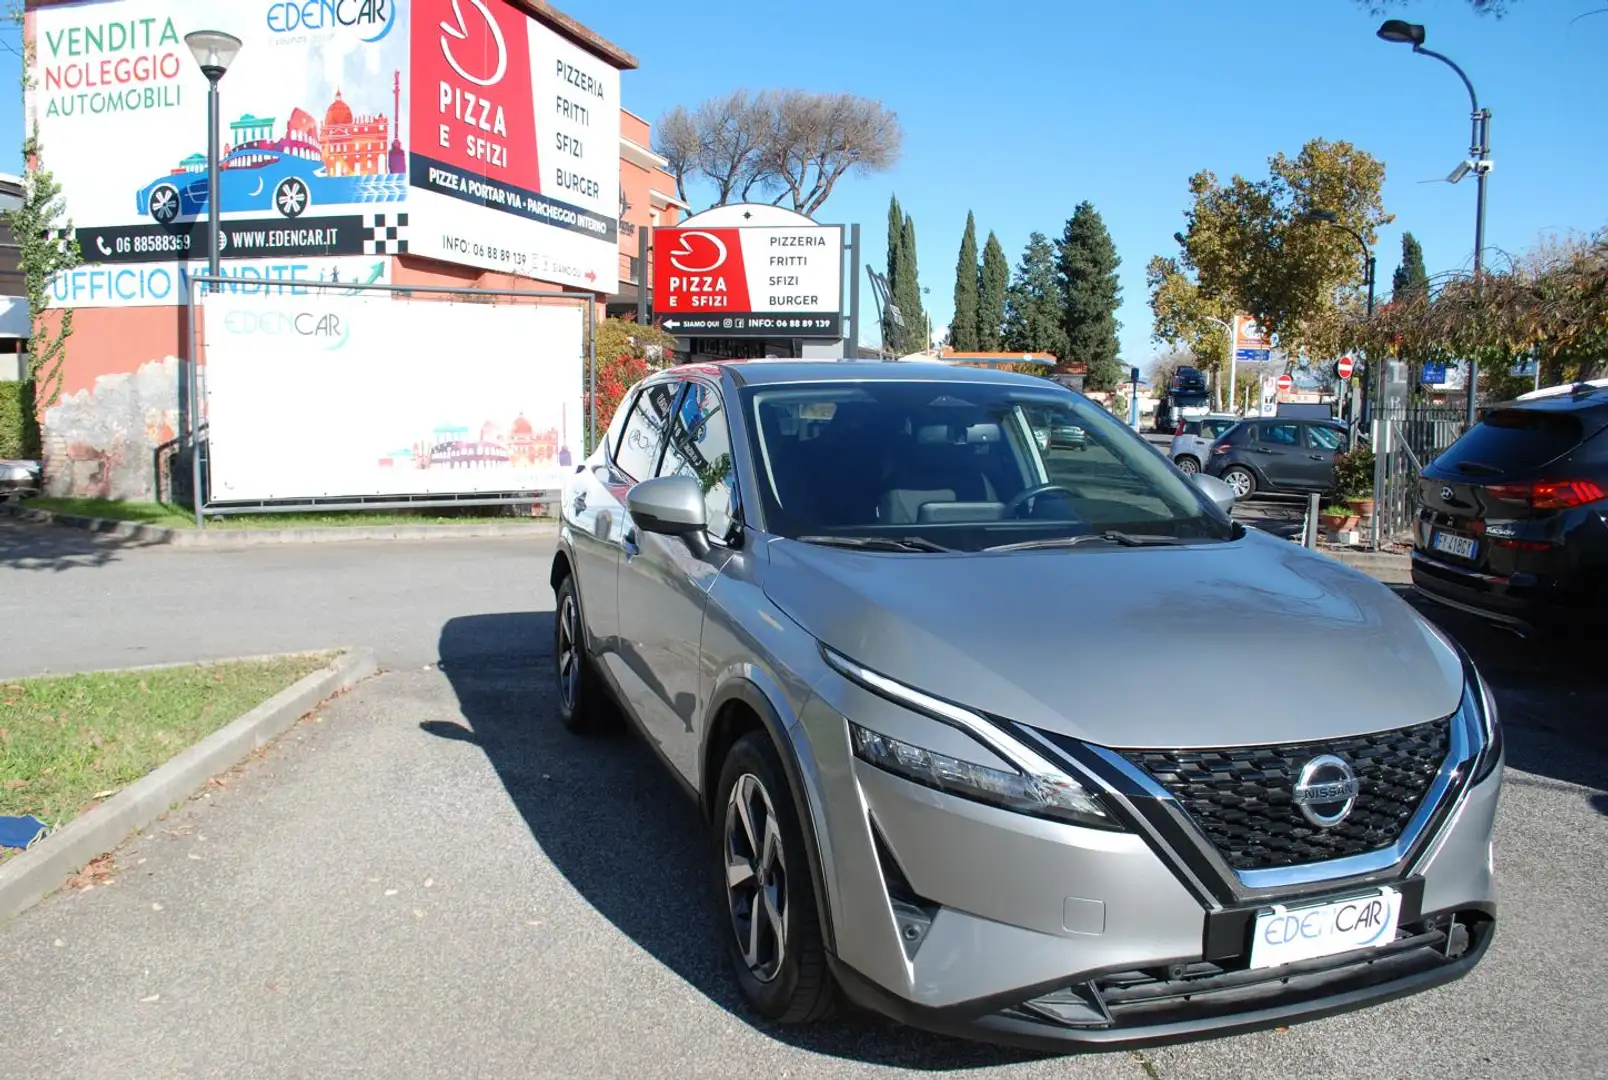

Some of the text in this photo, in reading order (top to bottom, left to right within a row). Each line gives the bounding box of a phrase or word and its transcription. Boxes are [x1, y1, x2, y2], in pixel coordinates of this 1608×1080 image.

[267, 0, 386, 32] EDENCAR
[45, 16, 179, 58] VENDITA
[45, 52, 180, 91] NOLEGGIO
[556, 59, 604, 100] PIZZERIA
[46, 85, 181, 118] AUTOMOBILI
[439, 80, 507, 138] PIZZA
[556, 95, 589, 127] FRITTI
[439, 124, 507, 168] E SFIZI
[556, 132, 583, 159] SFIZI
[556, 168, 599, 200] BURGER
[429, 167, 458, 191] PIZZE
[459, 178, 468, 193] A
[468, 180, 505, 203] PORTAR
[506, 191, 521, 209] VIA
[527, 198, 577, 225] PARCHEGGIO
[577, 216, 607, 234] INTERNO
[116, 234, 190, 253] 06 88588359
[232, 228, 338, 248] WWW.EDENCAR.IT
[442, 234, 471, 254] INFO:
[473, 243, 485, 257] 06
[487, 246, 498, 260] 88
[500, 249, 510, 262] 89
[513, 252, 527, 266] 139
[769, 236, 826, 247] PIZZERIA
[769, 256, 808, 266] FRITTI
[52, 267, 172, 301] UFFICIO
[669, 276, 728, 293] PIZZA
[769, 276, 799, 286] SFIZI
[669, 296, 728, 307] E SFIZI
[769, 295, 818, 306] BURGER
[224, 310, 341, 336] EDENCAR
[683, 319, 831, 329] SIAMO QUI INFO: 06 88 89 139
[1304, 783, 1353, 799] NISSAN
